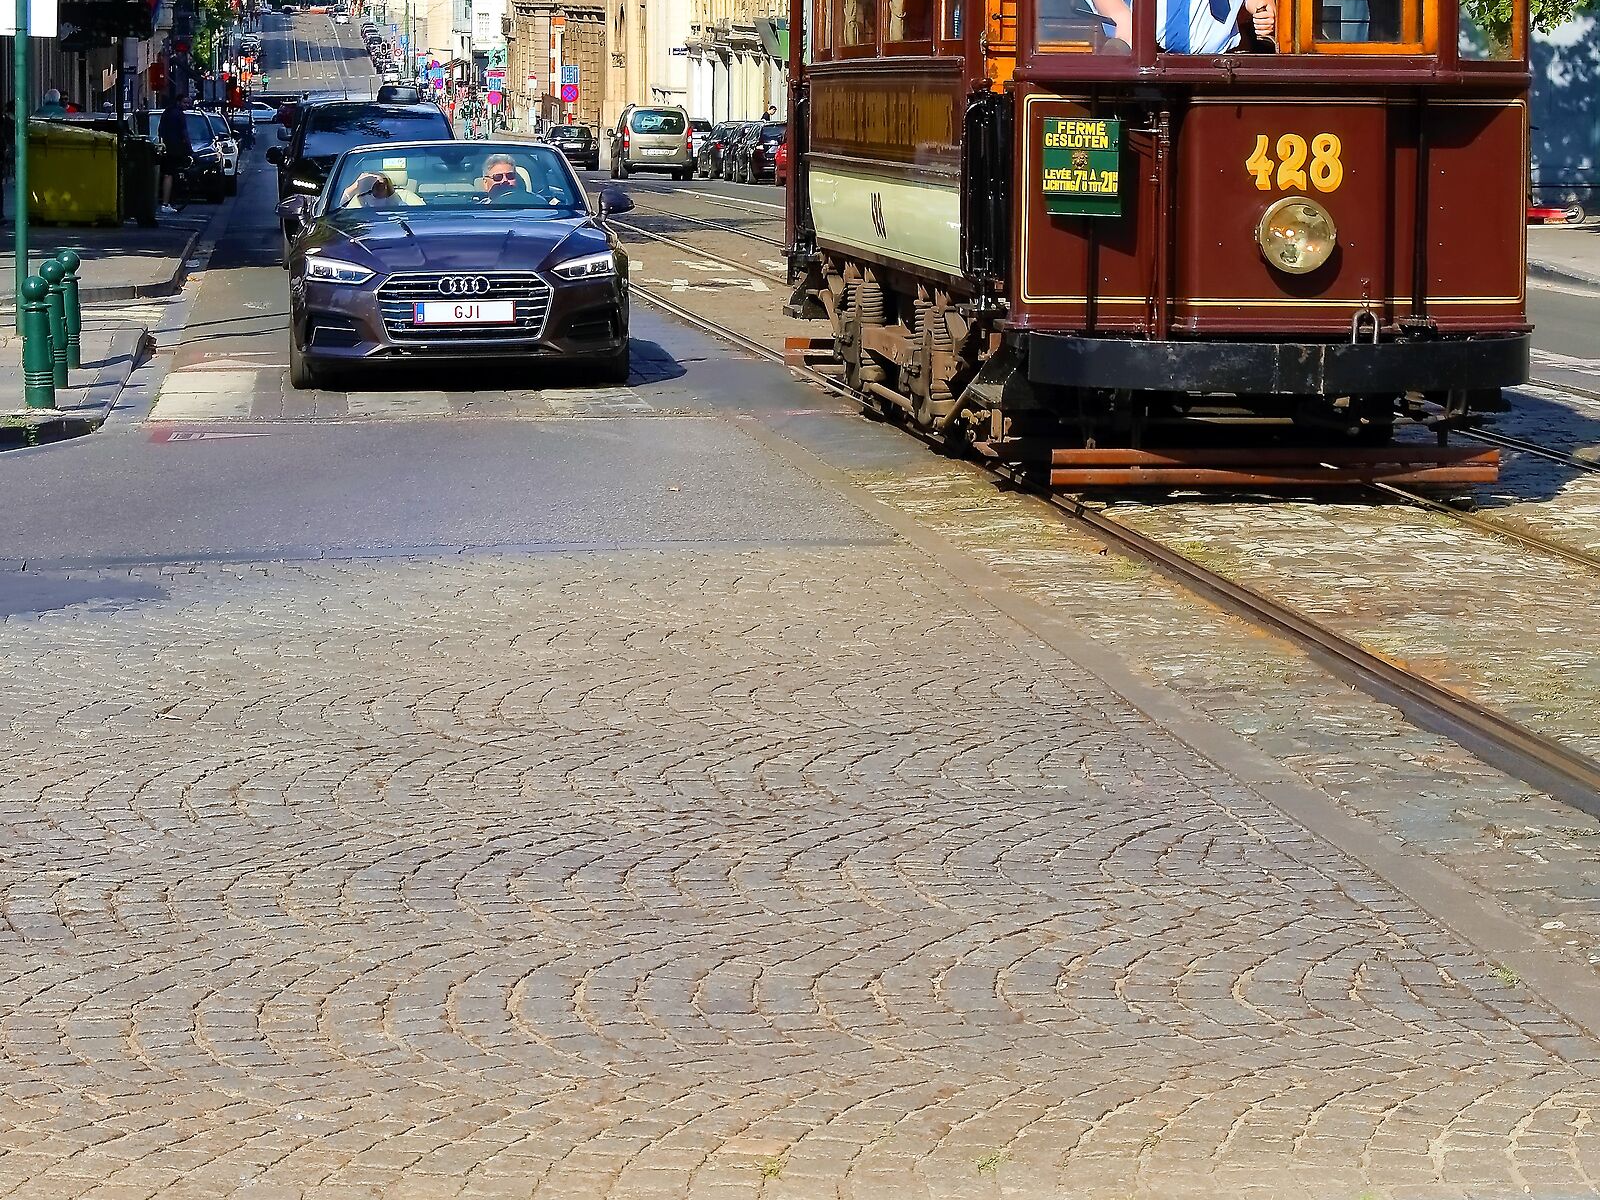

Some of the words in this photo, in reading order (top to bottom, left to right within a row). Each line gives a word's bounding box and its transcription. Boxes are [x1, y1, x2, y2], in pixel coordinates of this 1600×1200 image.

[1057, 121, 1106, 136] FERMÉ
[1045, 133, 1109, 148] GESLOTEN
[1245, 133, 1344, 193] 428
[1044, 168, 1072, 180] LEVÉE
[454, 305, 480, 319] GJI
